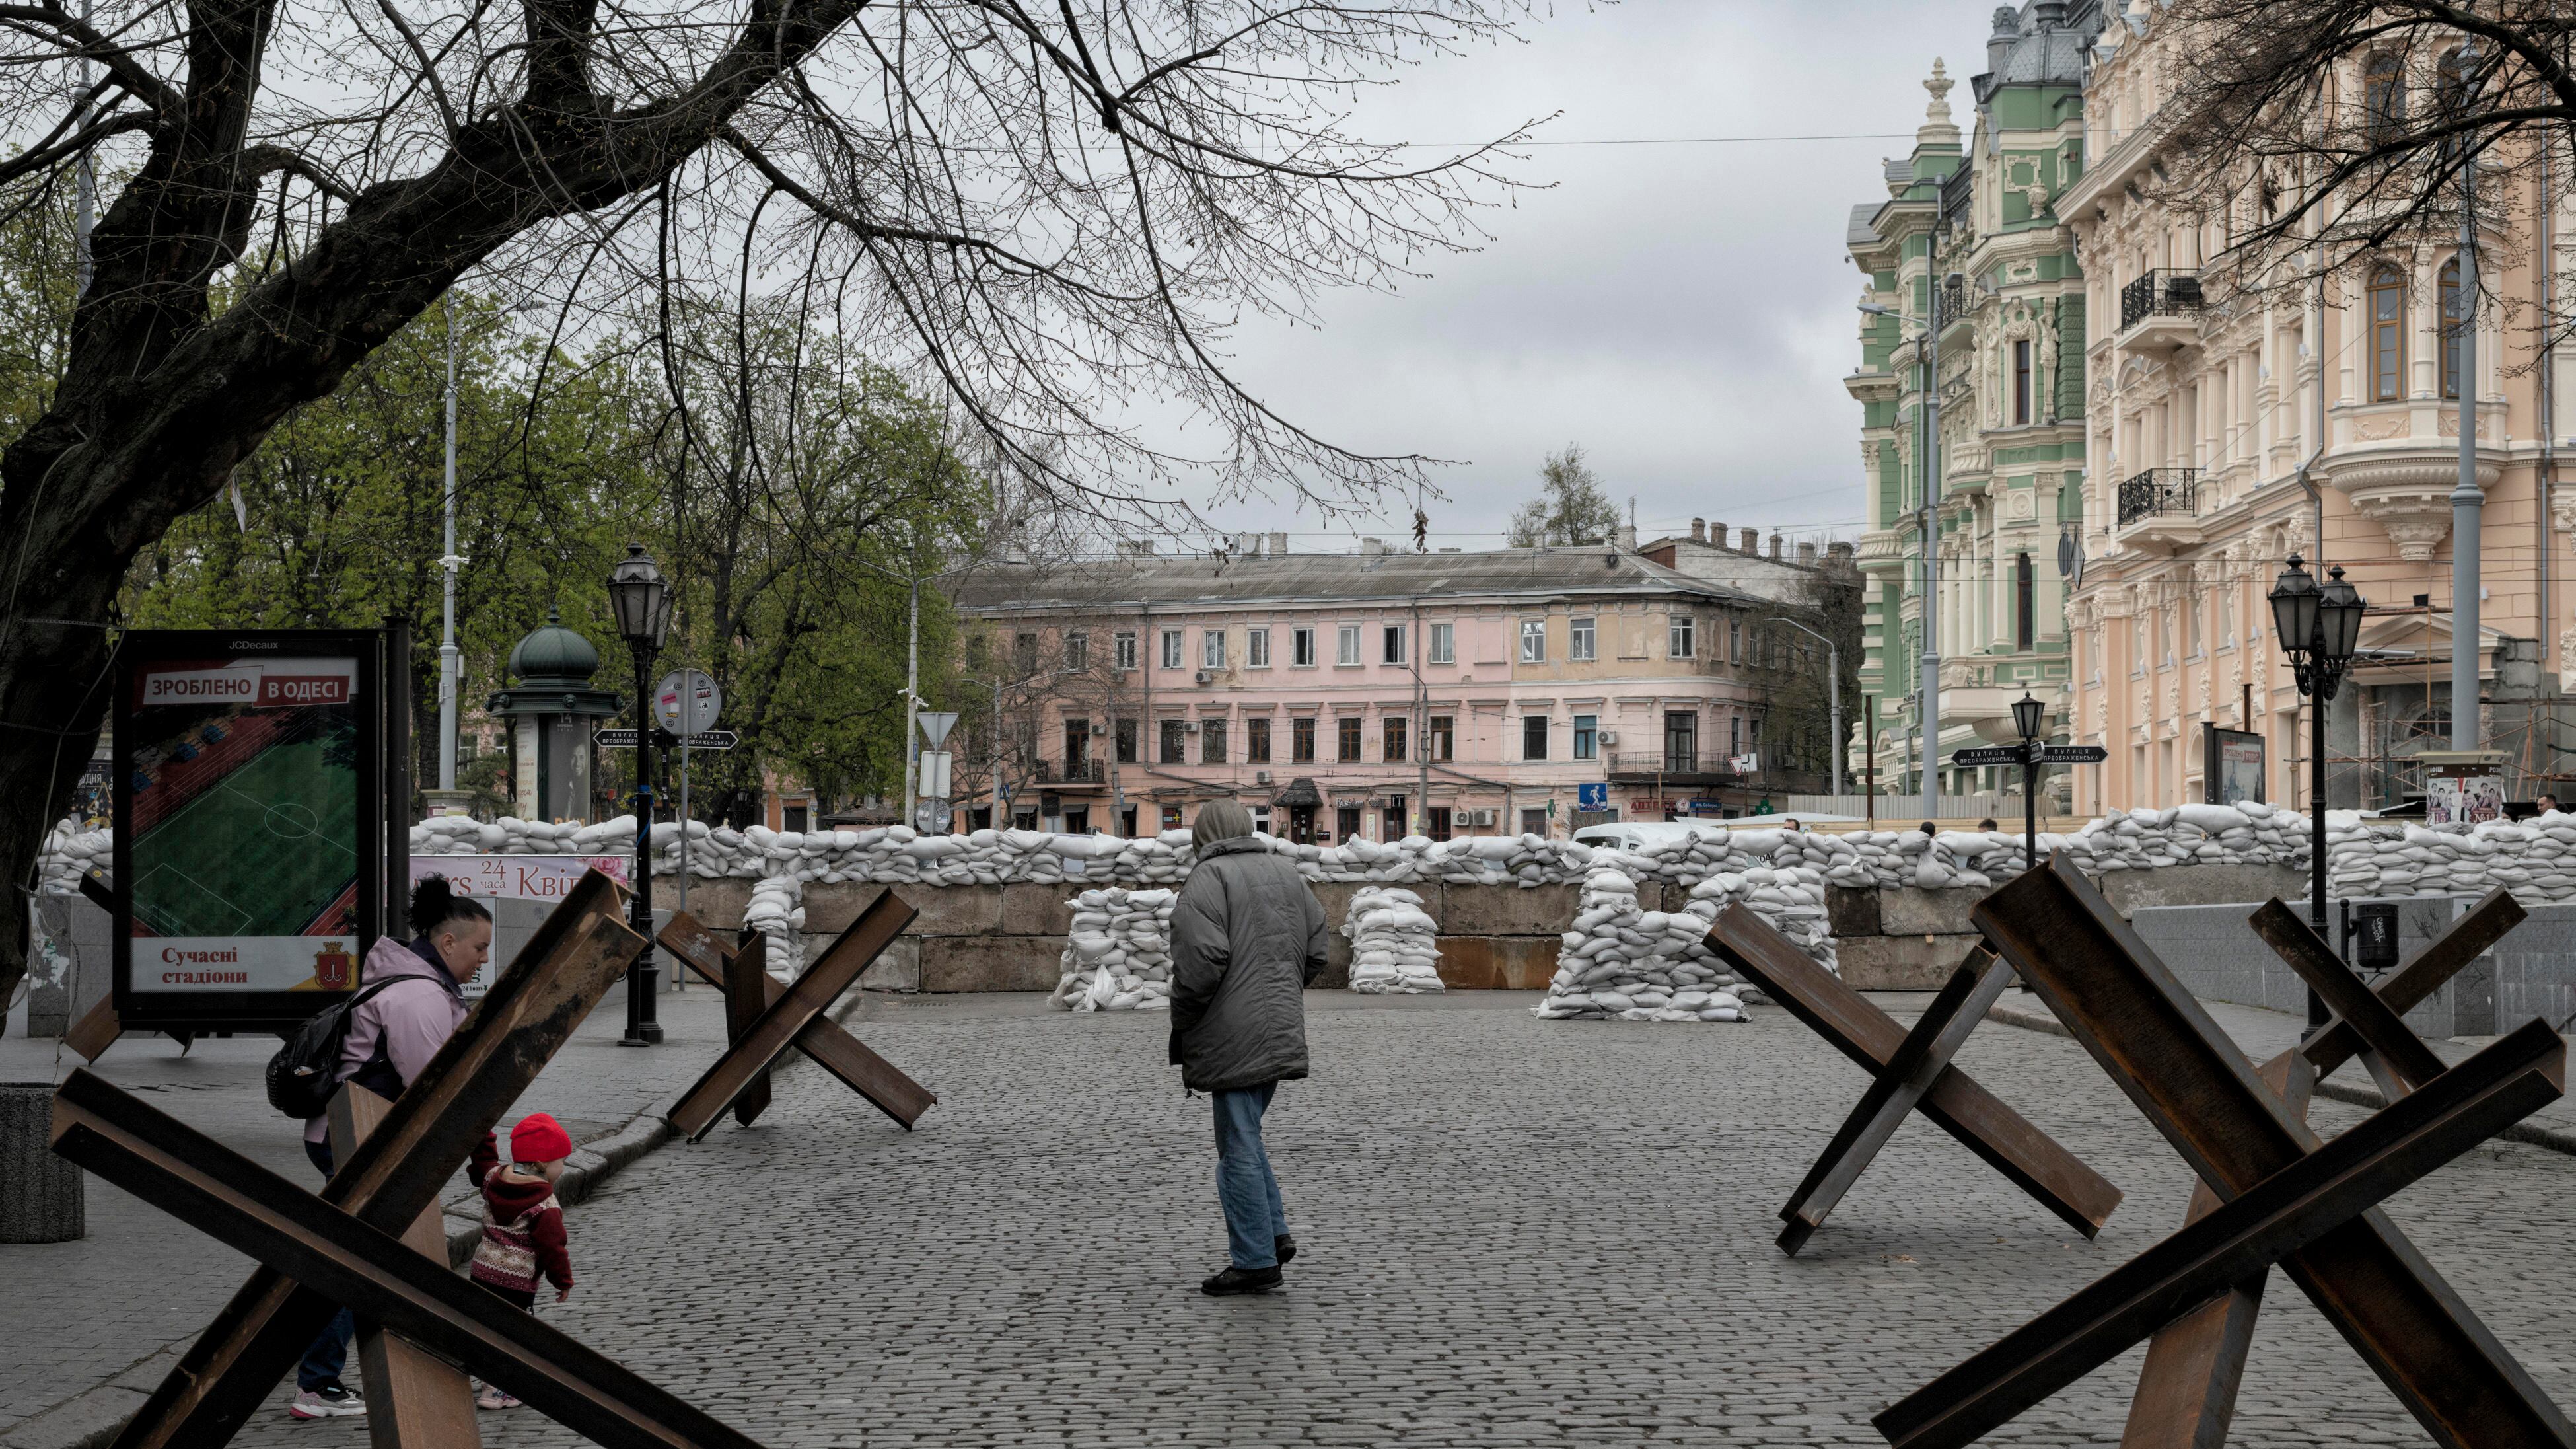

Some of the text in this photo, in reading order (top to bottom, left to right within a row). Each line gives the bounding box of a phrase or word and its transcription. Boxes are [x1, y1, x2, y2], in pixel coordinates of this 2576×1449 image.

[229, 640, 279, 650] JCDecaux
[152, 678, 339, 702] ЗРОБЛЕНО В ОДЕСІ
[1960, 756, 2015, 764] ПРЕОБРАЖЕНСЬКА
[480, 859, 507, 881] 24
[480, 880, 507, 889] часа
[161, 946, 238, 967] Сучасні
[161, 969, 248, 985] стадіони
